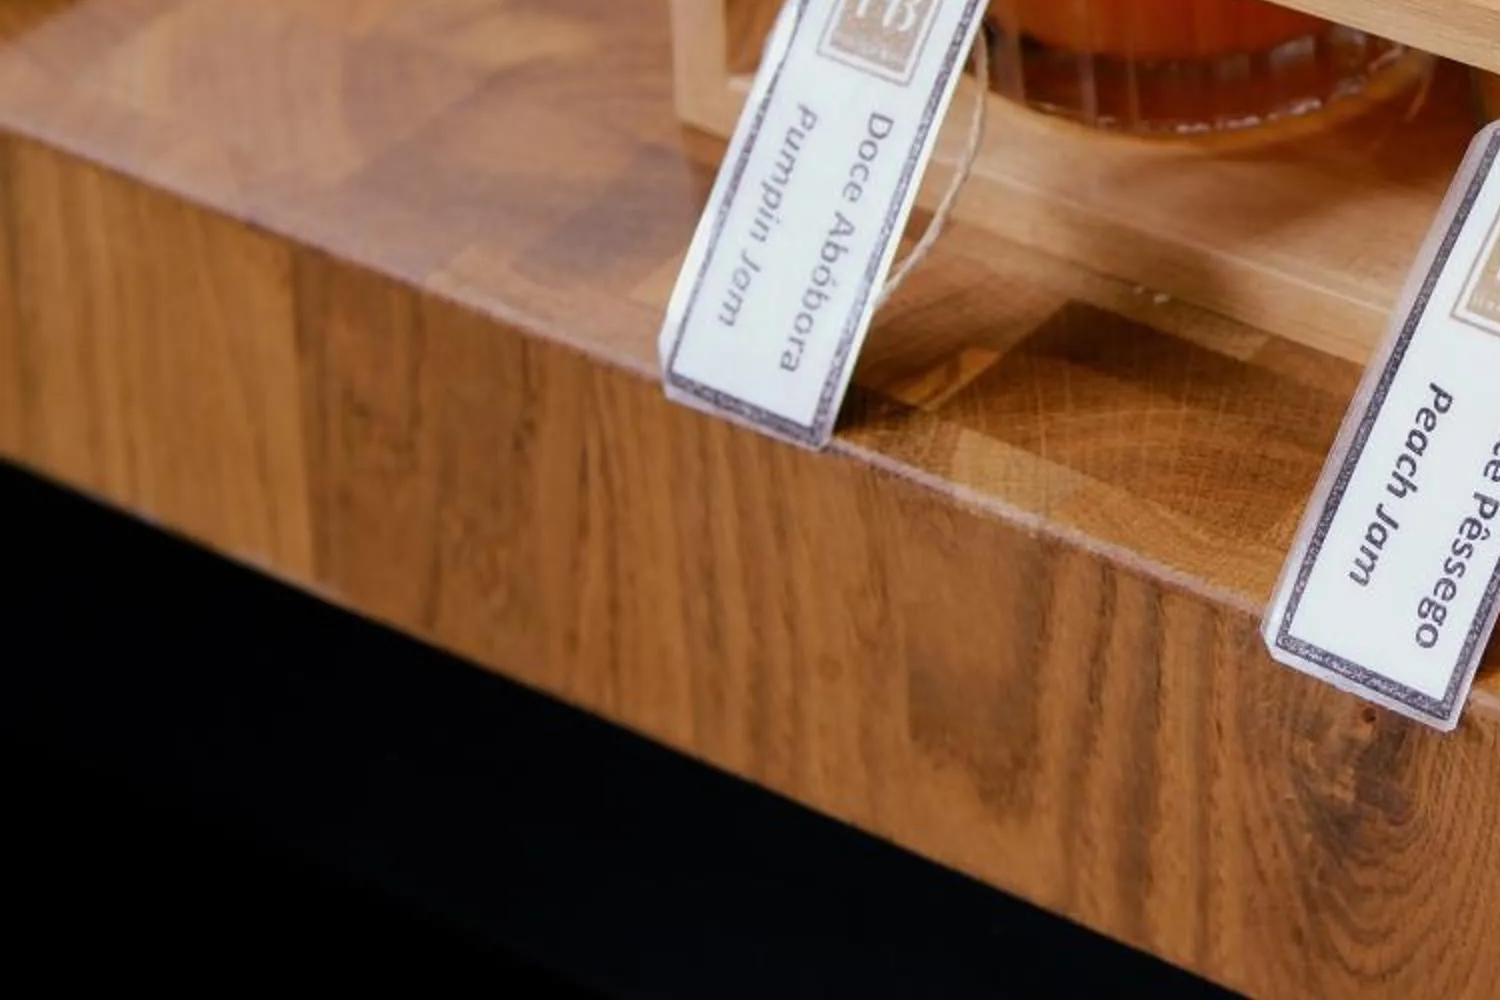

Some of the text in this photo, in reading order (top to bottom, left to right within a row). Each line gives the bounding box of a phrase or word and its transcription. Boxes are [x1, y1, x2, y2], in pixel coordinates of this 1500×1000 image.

[718, 103, 818, 328] Pumpin Jam
[842, 111, 895, 203] Doce
[779, 211, 856, 373] Abóbora
[1348, 382, 1454, 587] Peach Jam
[1415, 491, 1500, 649] Pêssego
